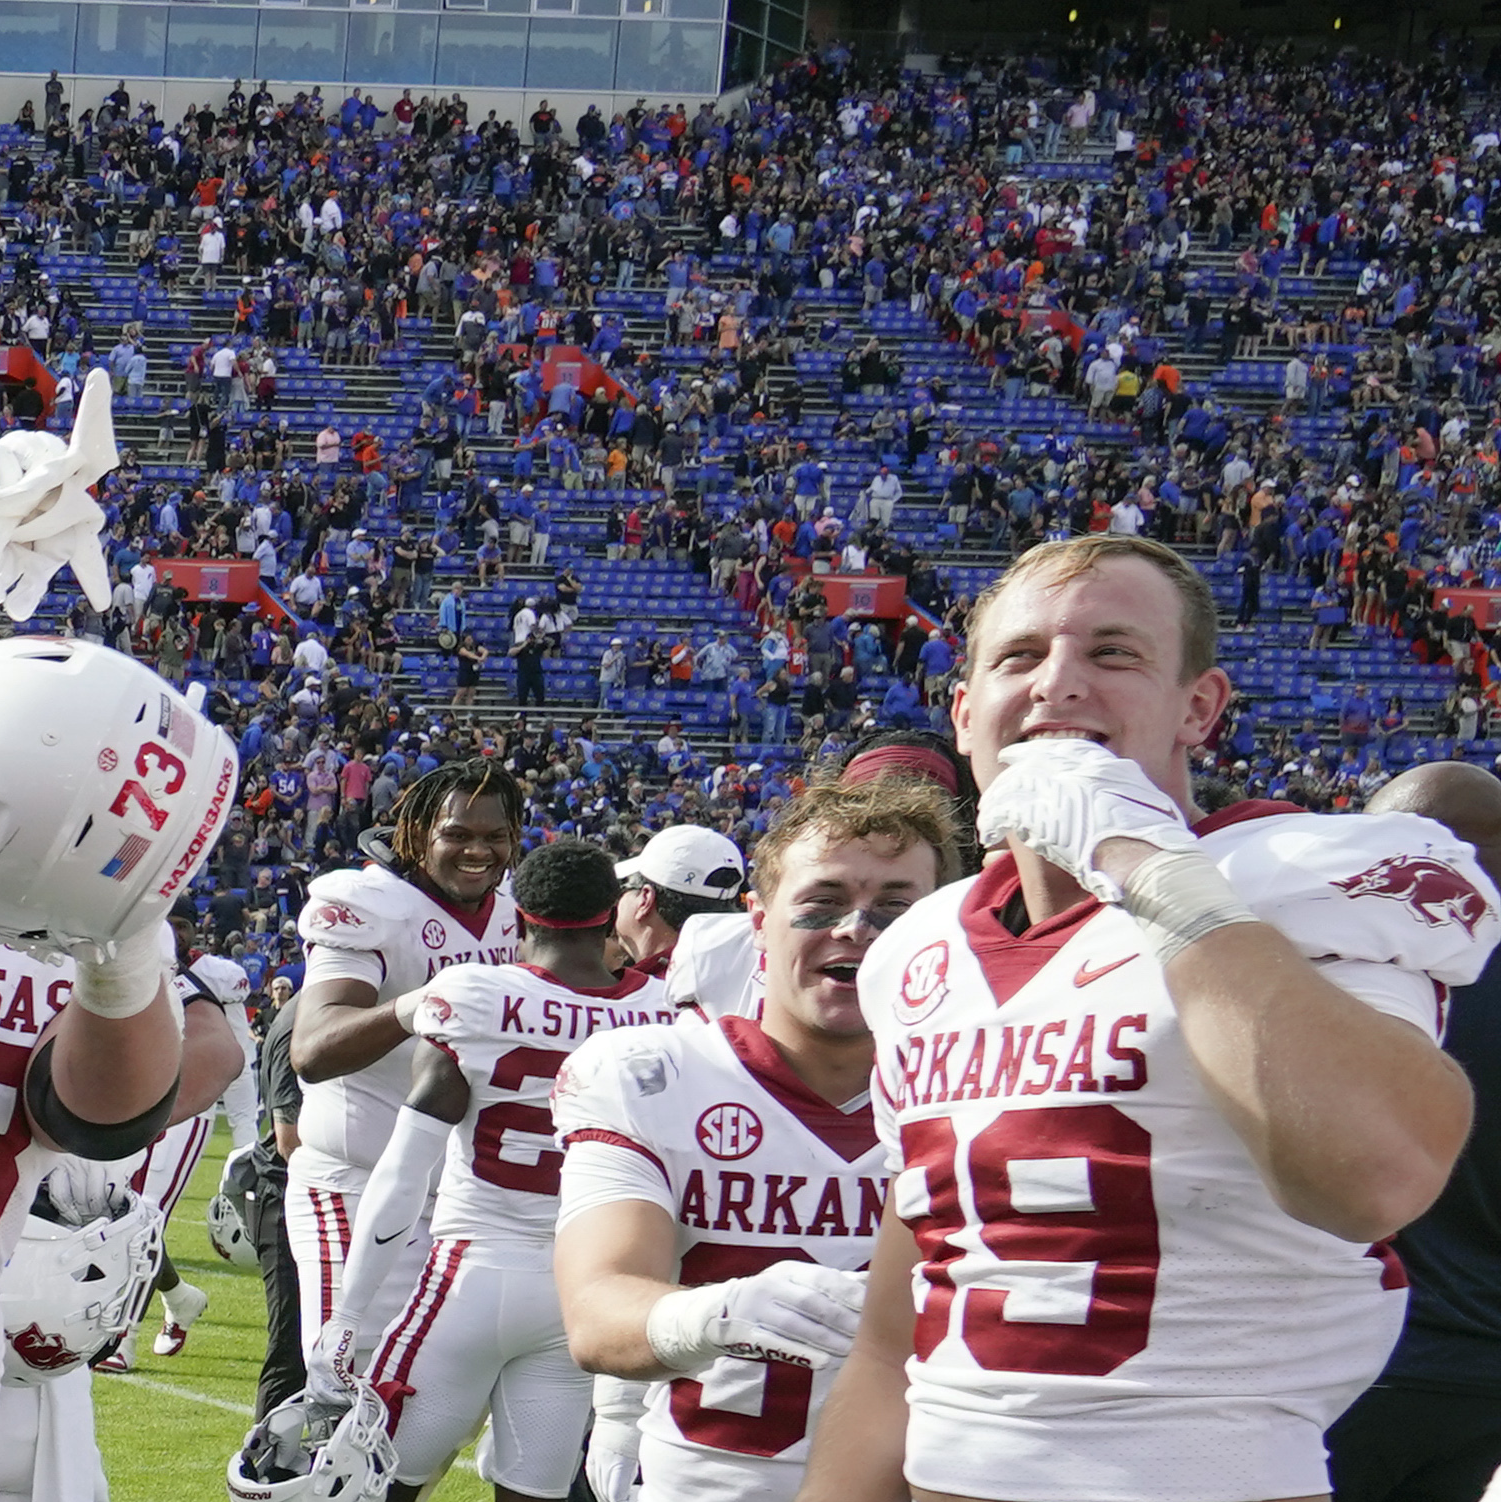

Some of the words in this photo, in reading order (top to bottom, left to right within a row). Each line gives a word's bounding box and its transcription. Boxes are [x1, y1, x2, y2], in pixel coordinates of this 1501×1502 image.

[854, 593, 871, 606] 10
[108, 741, 187, 832] 73
[278, 779, 295, 794] 54
[158, 757, 234, 898] RAZORBACKS
[424, 921, 445, 947] SEC
[426, 946, 519, 978] ARKANSA
[701, 1106, 758, 1160] SEC
